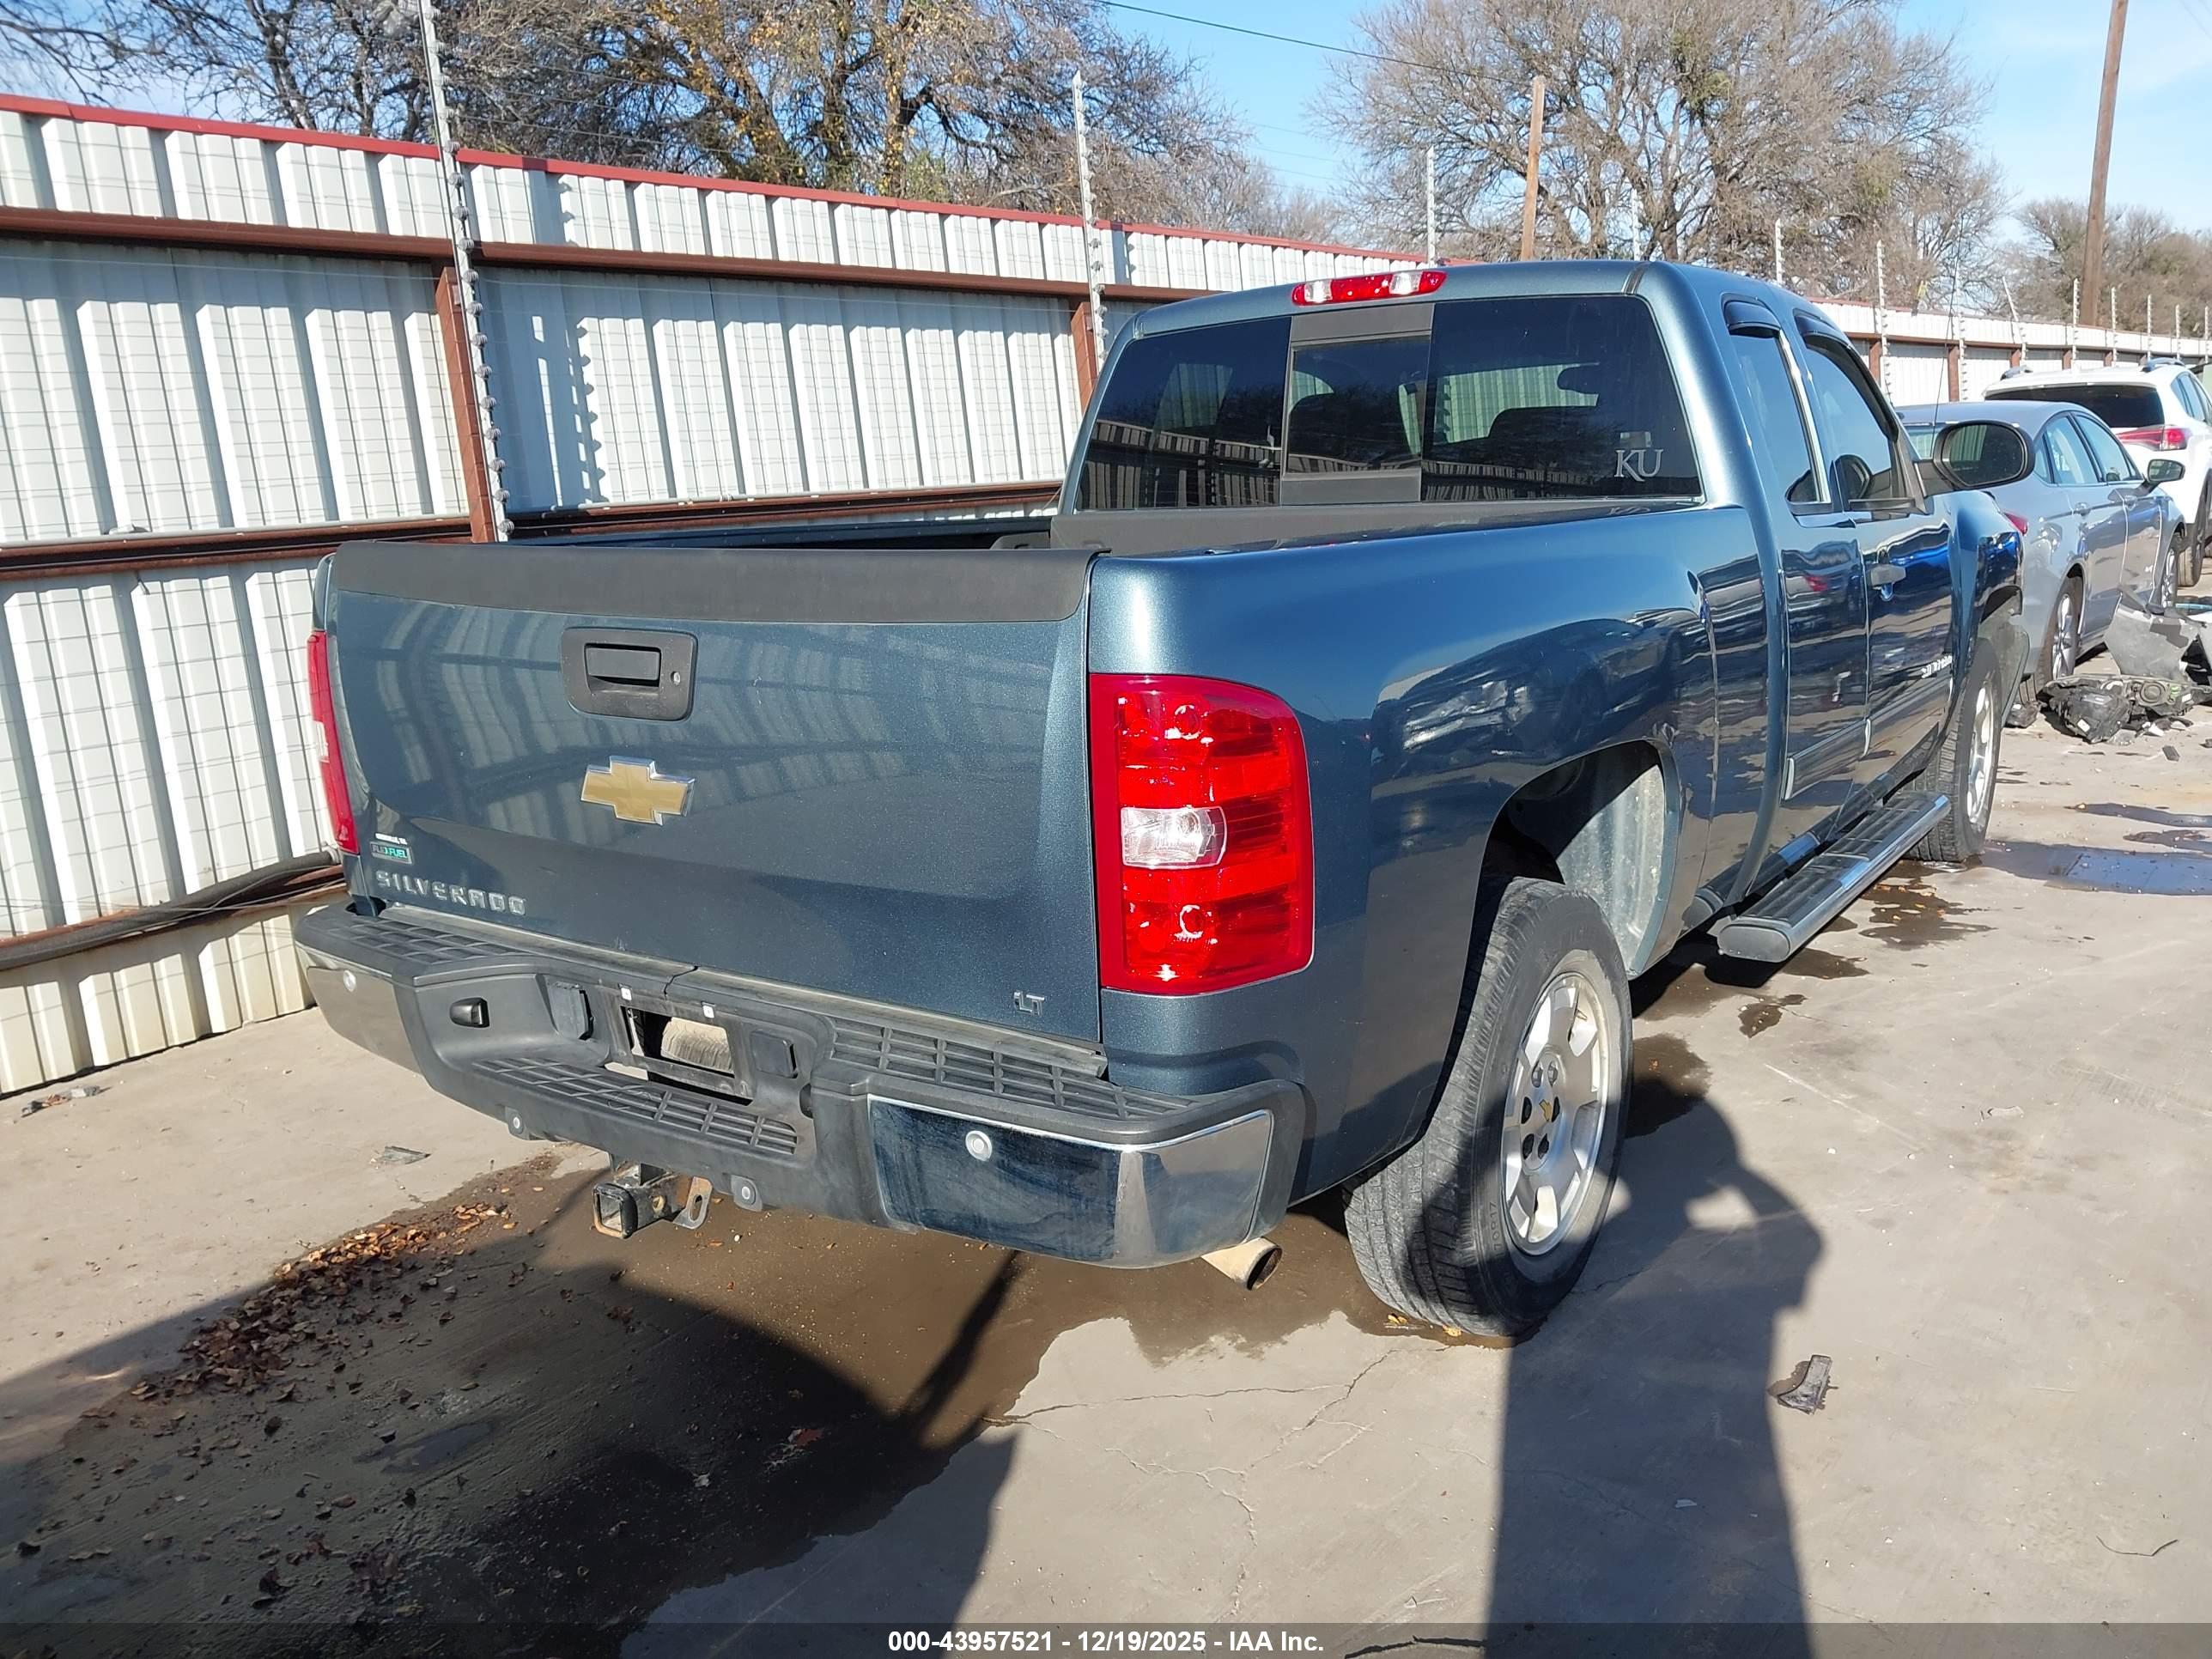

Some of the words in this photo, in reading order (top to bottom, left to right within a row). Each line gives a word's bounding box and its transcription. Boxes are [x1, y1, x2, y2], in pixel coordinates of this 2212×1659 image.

[1613, 449, 1664, 482] KU
[375, 870, 526, 915] SILVERADO
[1013, 990, 1046, 1016] LT
